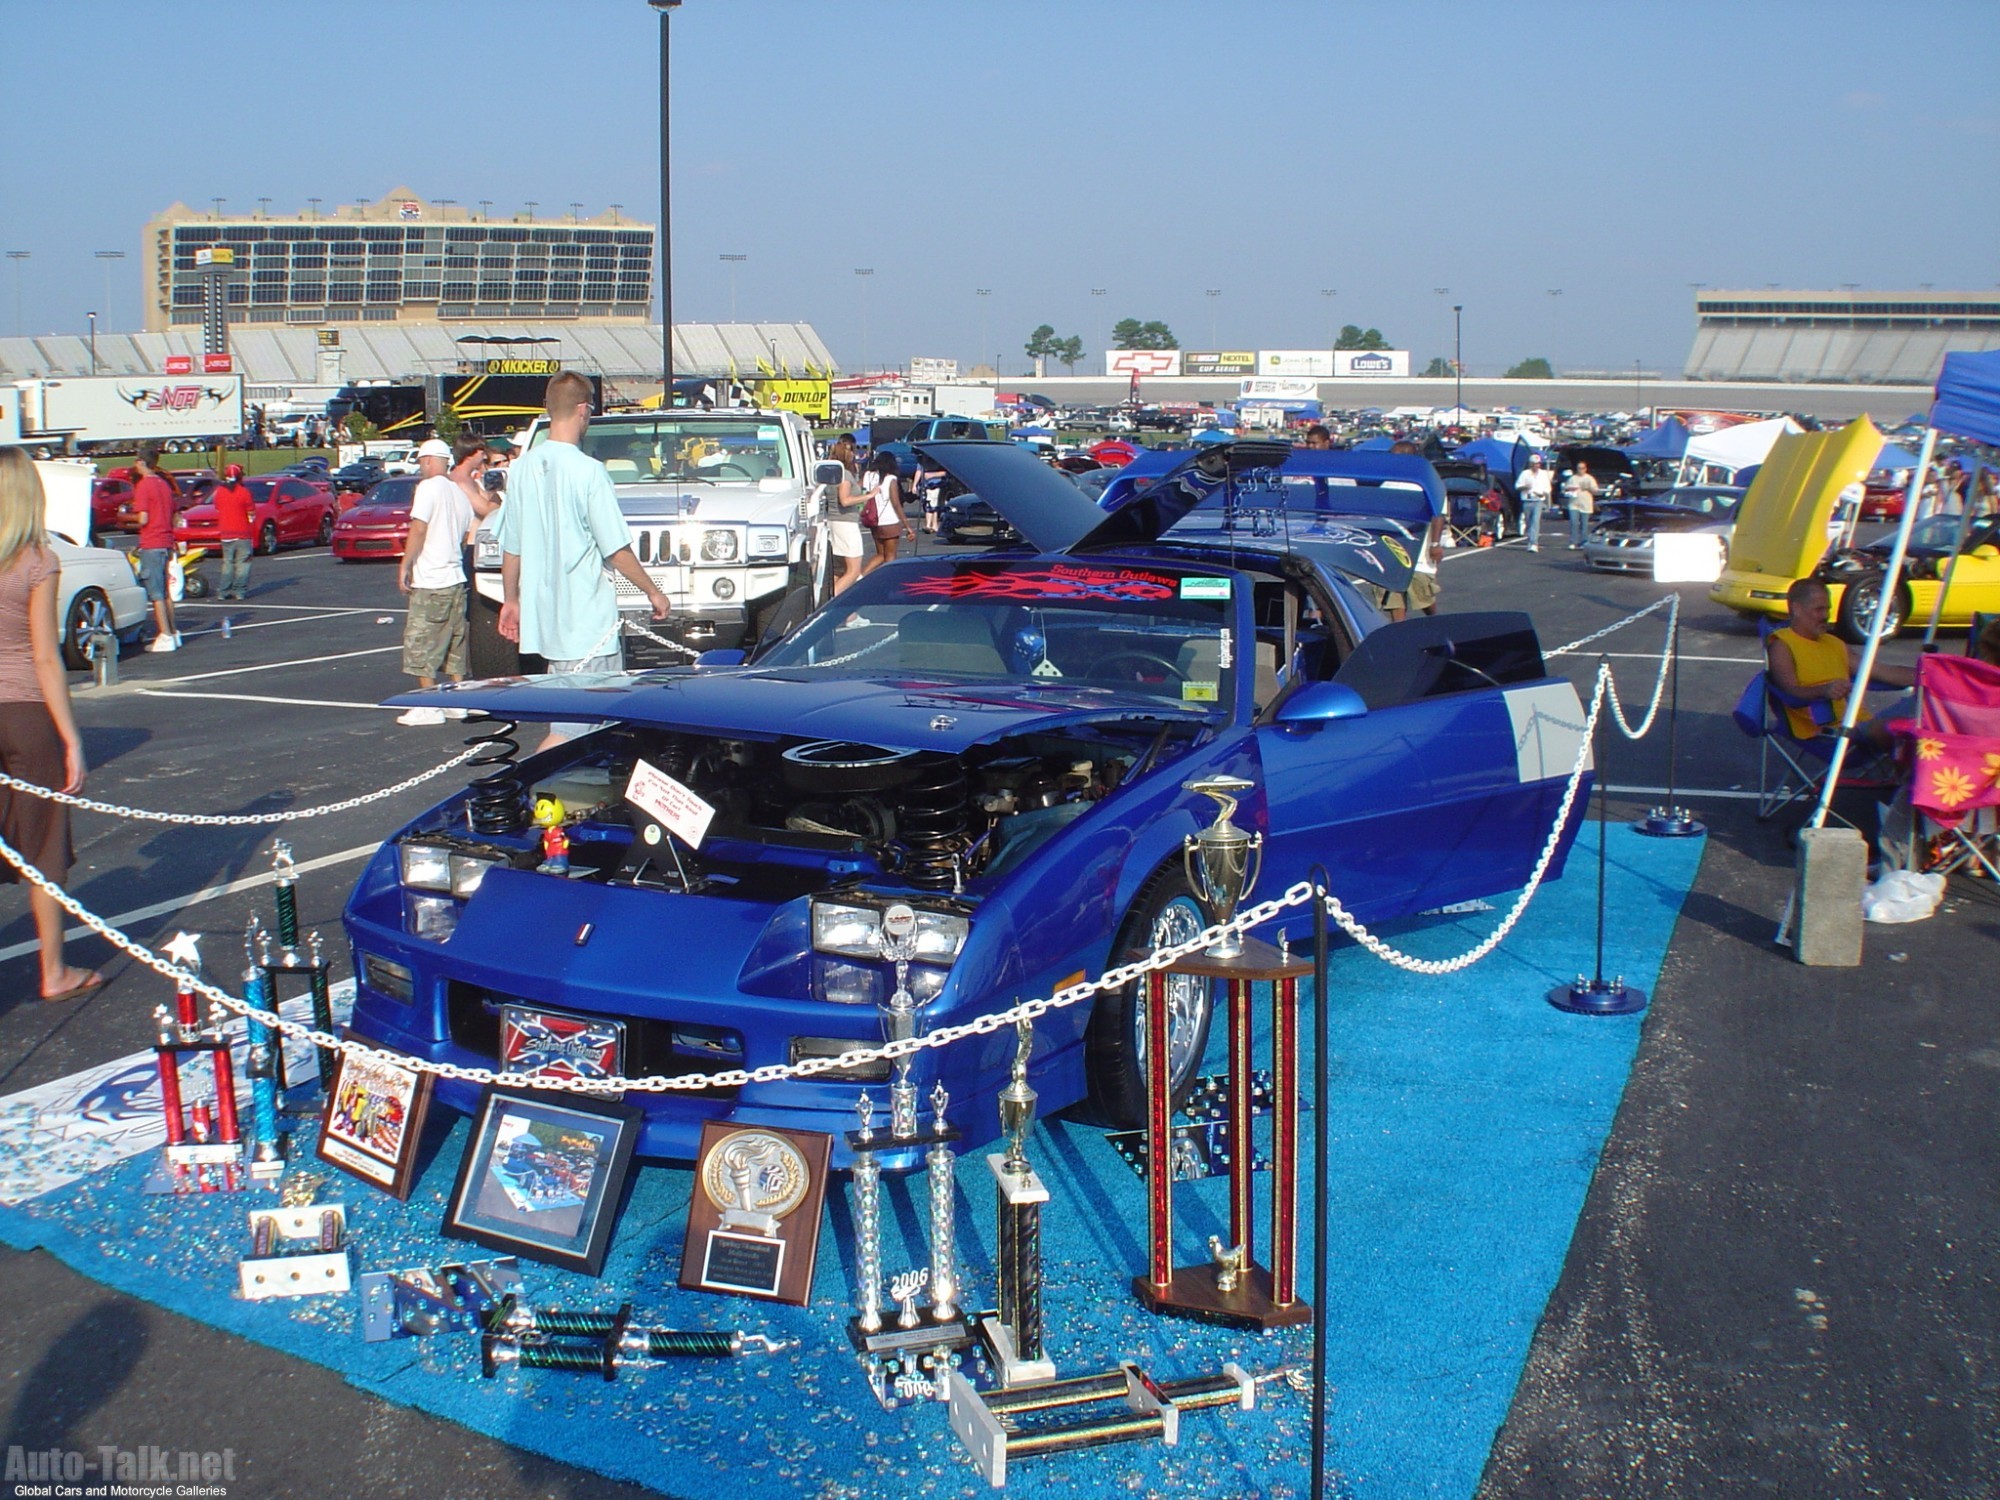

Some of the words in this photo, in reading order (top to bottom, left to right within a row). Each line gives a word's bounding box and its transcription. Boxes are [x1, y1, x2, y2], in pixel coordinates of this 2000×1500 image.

[510, 360, 549, 373] KICKER
[783, 391, 827, 404] DUNLOP
[1051, 564, 1116, 579] Southern
[1119, 570, 1178, 588] Outlaws
[891, 1267, 929, 1287] 2006
